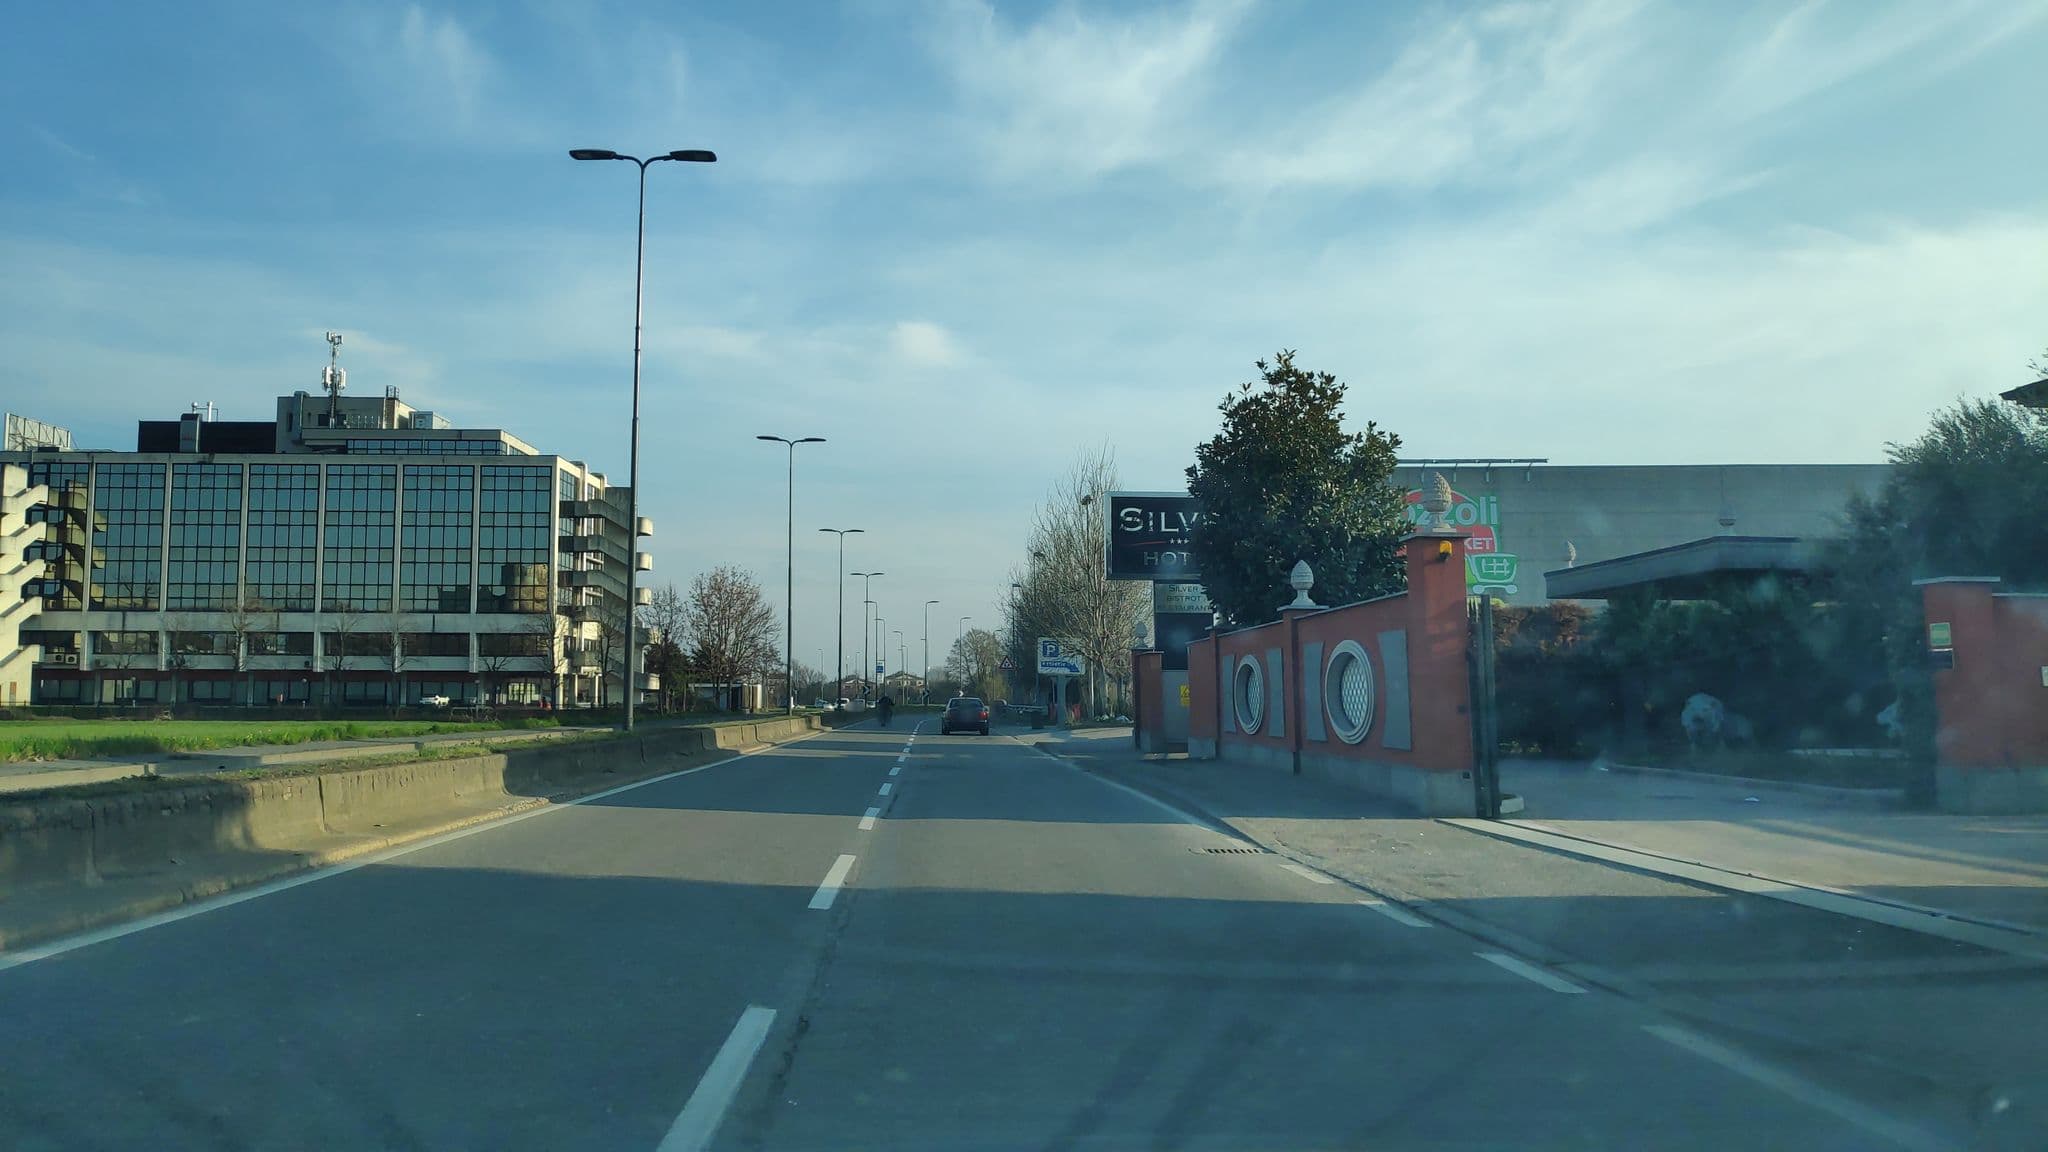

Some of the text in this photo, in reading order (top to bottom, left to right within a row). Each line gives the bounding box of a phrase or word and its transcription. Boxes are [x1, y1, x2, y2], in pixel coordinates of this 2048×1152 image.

[1120, 507, 1200, 532] SILV
[1464, 538, 1493, 550] KET
[1144, 552, 1192, 566] HOT
